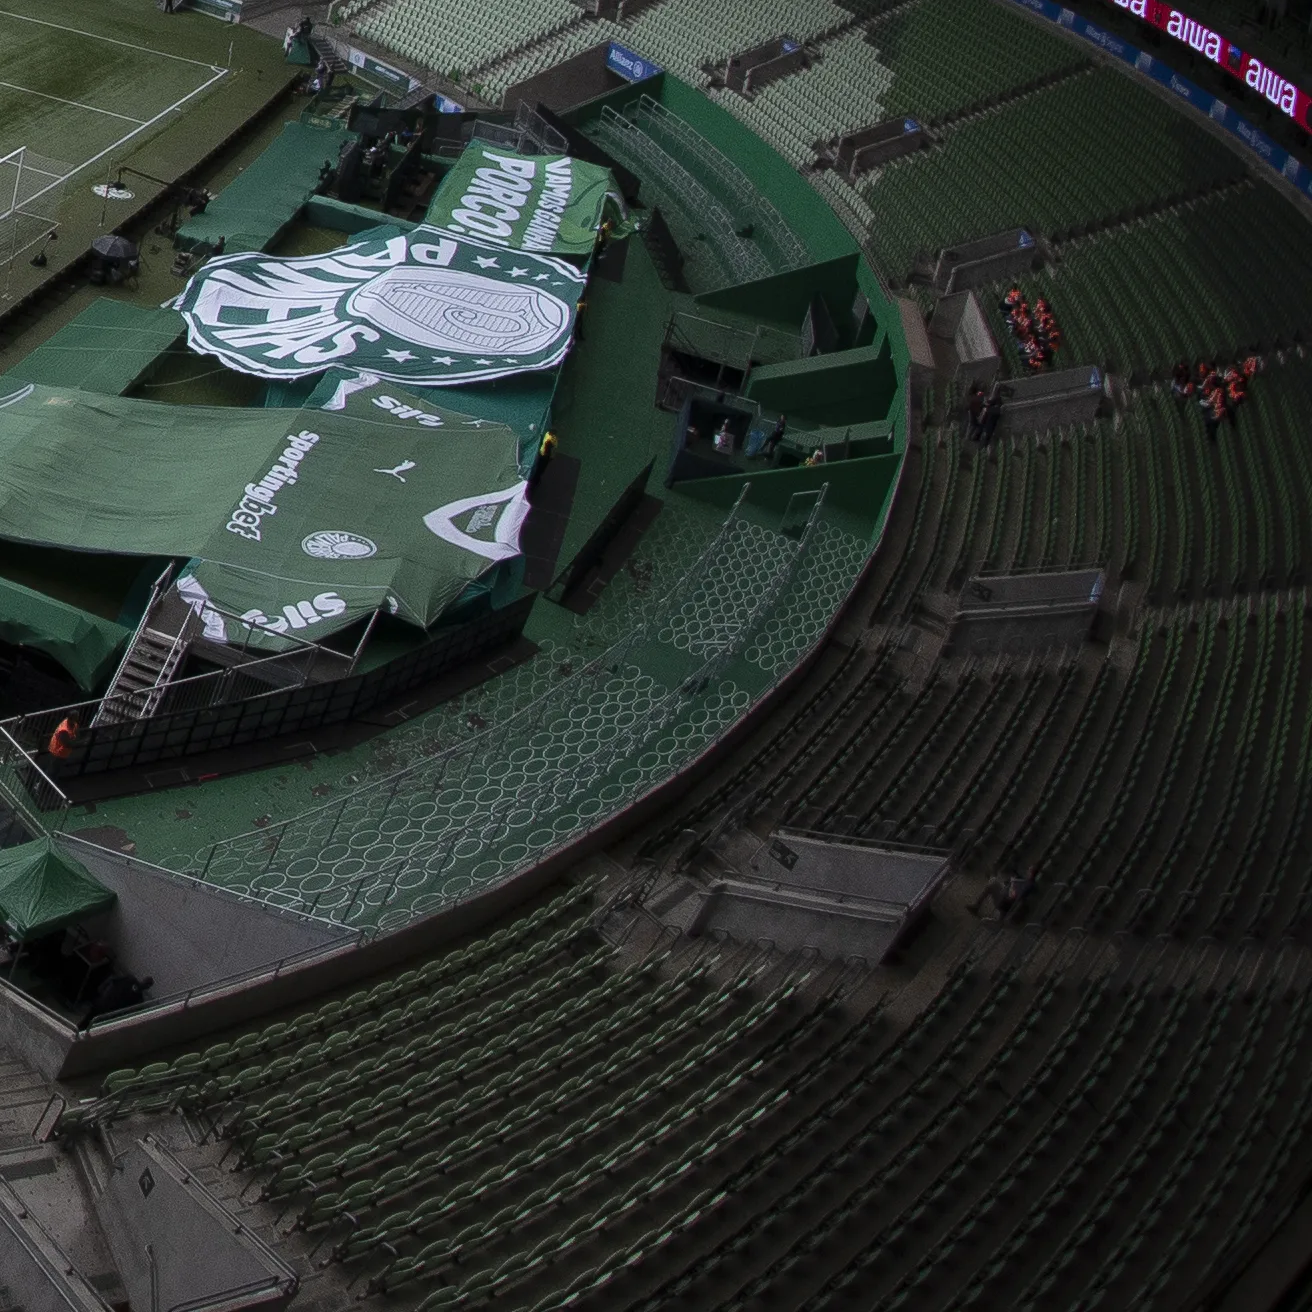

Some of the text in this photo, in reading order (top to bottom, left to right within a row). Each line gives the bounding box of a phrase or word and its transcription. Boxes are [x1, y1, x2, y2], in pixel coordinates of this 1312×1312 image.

[610, 49, 634, 71] Allianz
[1167, 11, 1221, 63] aiwa
[1245, 58, 1296, 117] aiwa
[447, 151, 536, 247] PORCO!
[537, 156, 572, 214] VAMOS
[225, 429, 320, 542] sportingbet
